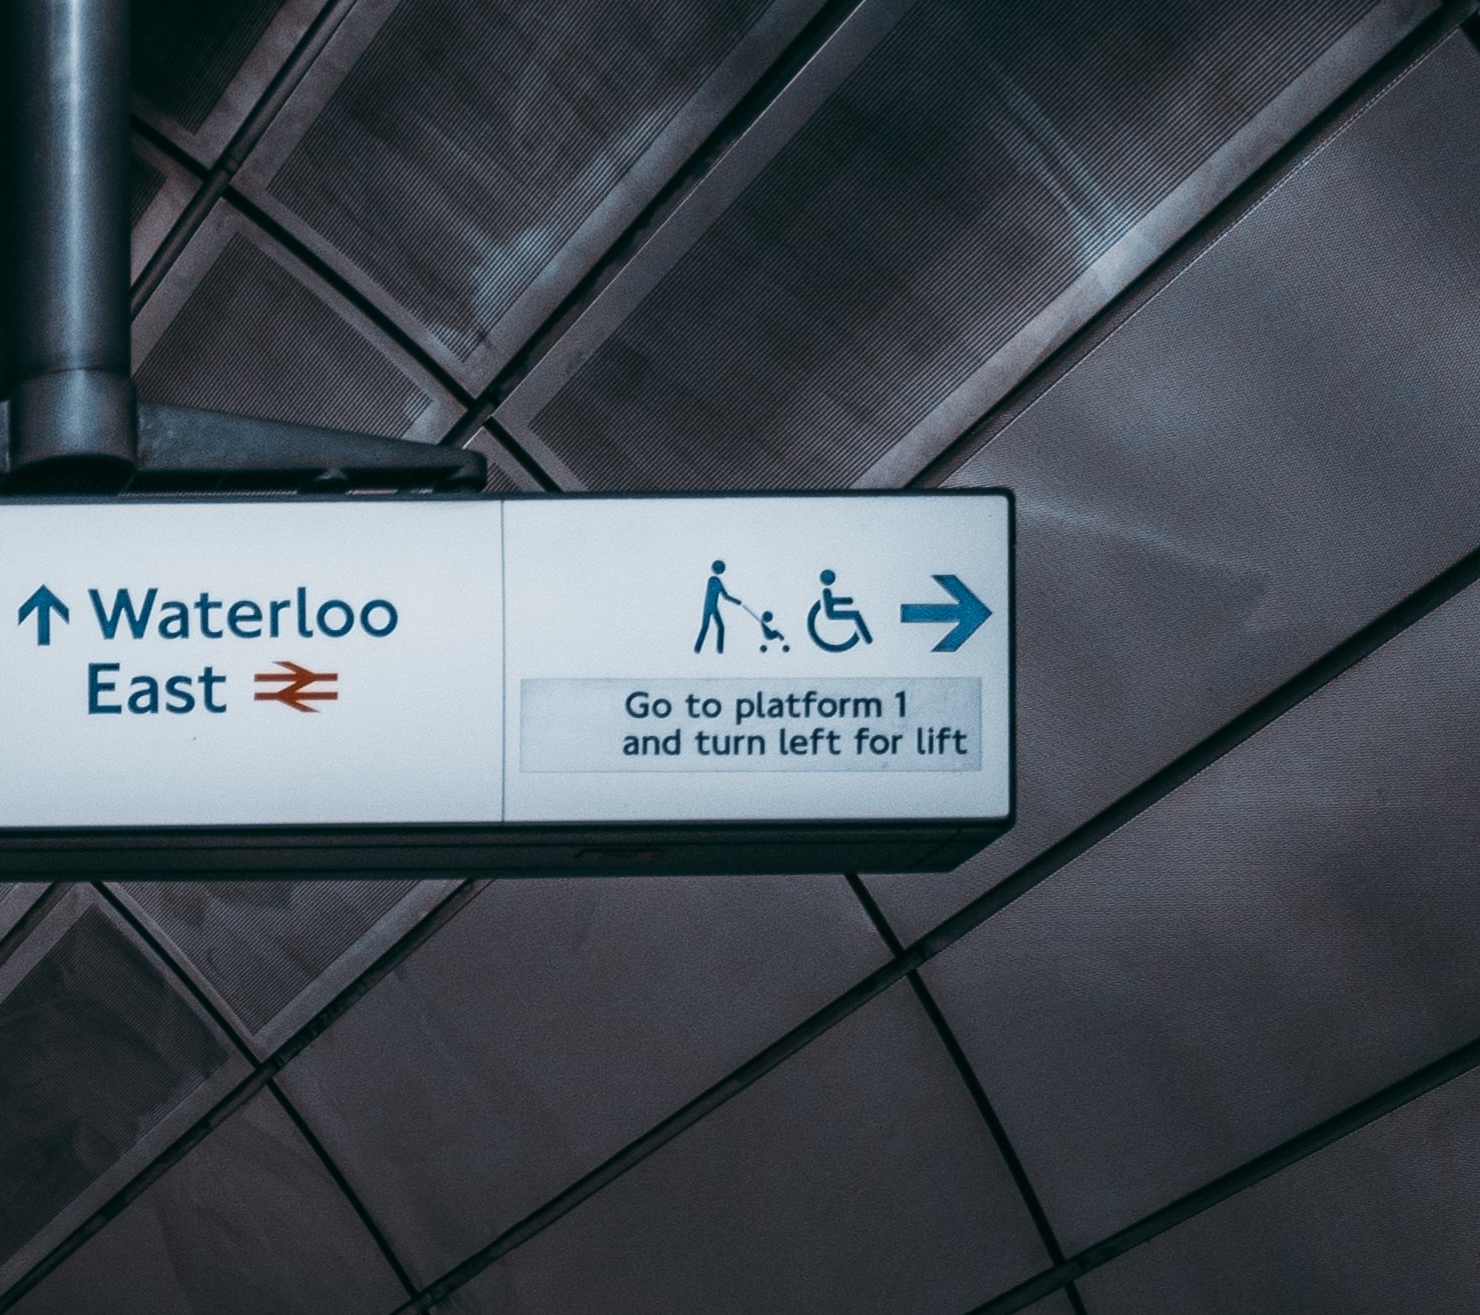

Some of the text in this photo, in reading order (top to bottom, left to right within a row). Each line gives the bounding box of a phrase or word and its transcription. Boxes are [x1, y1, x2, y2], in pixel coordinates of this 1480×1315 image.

[88, 586, 399, 640] Waterloo
[88, 662, 228, 715] East
[624, 690, 907, 727] Go to platform 1
[622, 726, 968, 757] and turn left for lift
